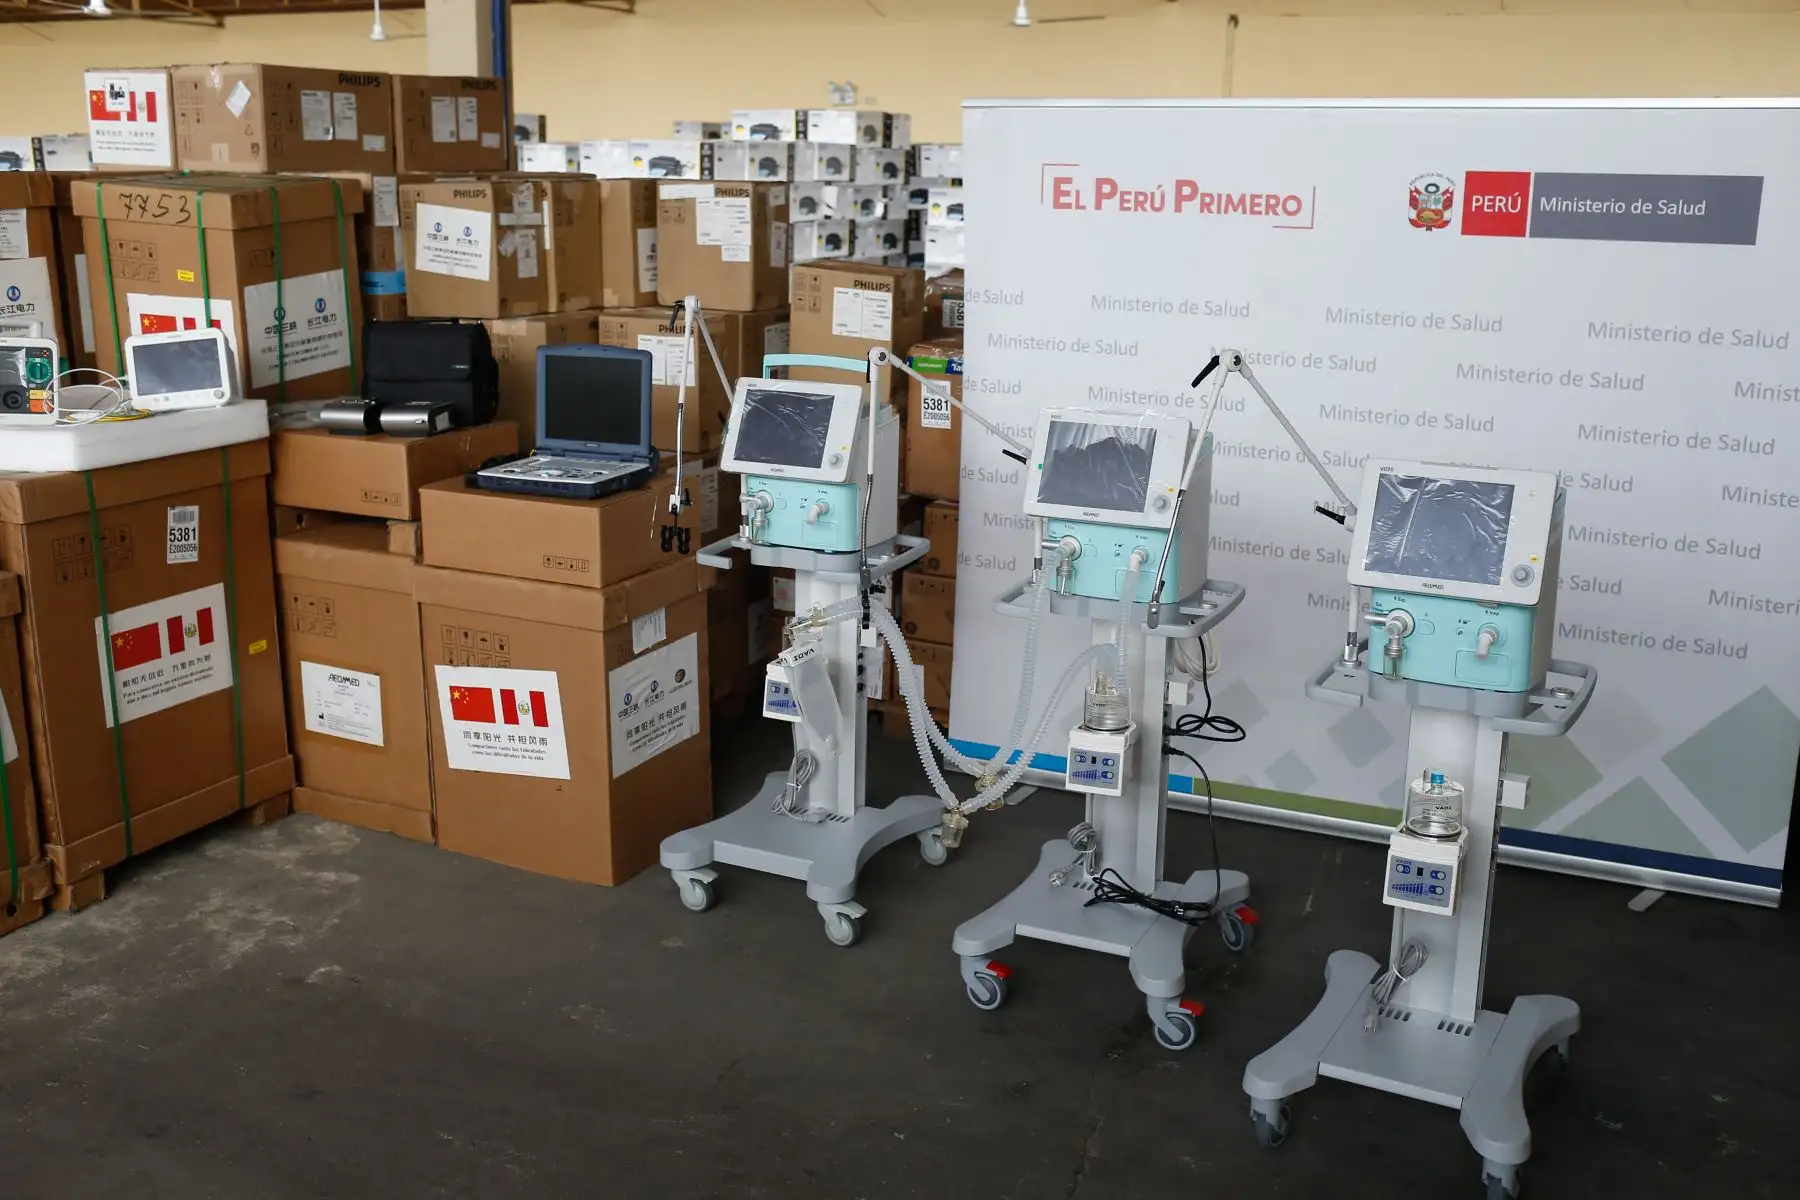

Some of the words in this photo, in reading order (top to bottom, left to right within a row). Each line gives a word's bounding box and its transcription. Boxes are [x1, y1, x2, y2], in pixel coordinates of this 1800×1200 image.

[338, 72, 381, 88] PHILIPS
[462, 78, 498, 91] PHILIPS
[453, 188, 487, 199] PHILIPS
[716, 188, 750, 198] PHILIPS
[1052, 176, 1086, 211] EL
[1095, 177, 1165, 213] PERÚ
[1174, 179, 1302, 217] PRIMERO
[1472, 192, 1522, 214] PERÚ
[1540, 196, 1626, 214] Ministerio
[1631, 198, 1652, 215] de
[1657, 199, 1706, 216] Salud
[854, 280, 891, 292] PHILIPS
[965, 288, 980, 303] de
[984, 289, 1024, 306] Salud
[1091, 294, 1174, 314] Ministerio
[1178, 299, 1198, 314] de
[1204, 300, 1250, 318] Salud
[1325, 307, 1416, 328] Ministerio
[1422, 311, 1446, 330] de
[1452, 313, 1502, 334] Salud
[988, 333, 1066, 352] Ministerio
[1071, 337, 1090, 353] de
[1095, 339, 1138, 356] Salud
[1588, 321, 1691, 344] Ministerio
[1698, 326, 1724, 346] de
[1730, 329, 1789, 351] Salud
[1302, 353, 1322, 369] de
[1329, 354, 1377, 372] Salud
[963, 376, 977, 391] de
[980, 378, 1022, 395] Salud
[1456, 364, 1553, 386] Ministerio
[1560, 368, 1583, 388] de
[1589, 370, 1644, 392] Salud
[923, 398, 949, 411] 5381
[1088, 386, 1169, 406] Ministerio
[1174, 392, 1194, 408] de
[1319, 404, 1409, 426] Ministerio
[1415, 408, 1438, 428] de
[1444, 411, 1494, 433] Salud
[1577, 423, 1680, 448] Ministerio
[1686, 431, 1712, 450] de
[1718, 433, 1776, 457] Salud
[960, 466, 975, 480] de
[978, 468, 1018, 484] Salud
[1579, 473, 1634, 492] Salud
[169, 527, 197, 544] 5381
[1568, 525, 1668, 550] Ministerio
[1674, 535, 1698, 554] de
[1705, 538, 1762, 560] Salud
[958, 552, 972, 566] de
[975, 554, 1016, 571] Salud
[1290, 545, 1311, 561] de
[1569, 575, 1622, 595] Salud
[1558, 622, 1656, 650] Ministerio
[1662, 630, 1687, 652] de
[1692, 636, 1748, 660] Salud
[793, 648, 814, 661] VADI
